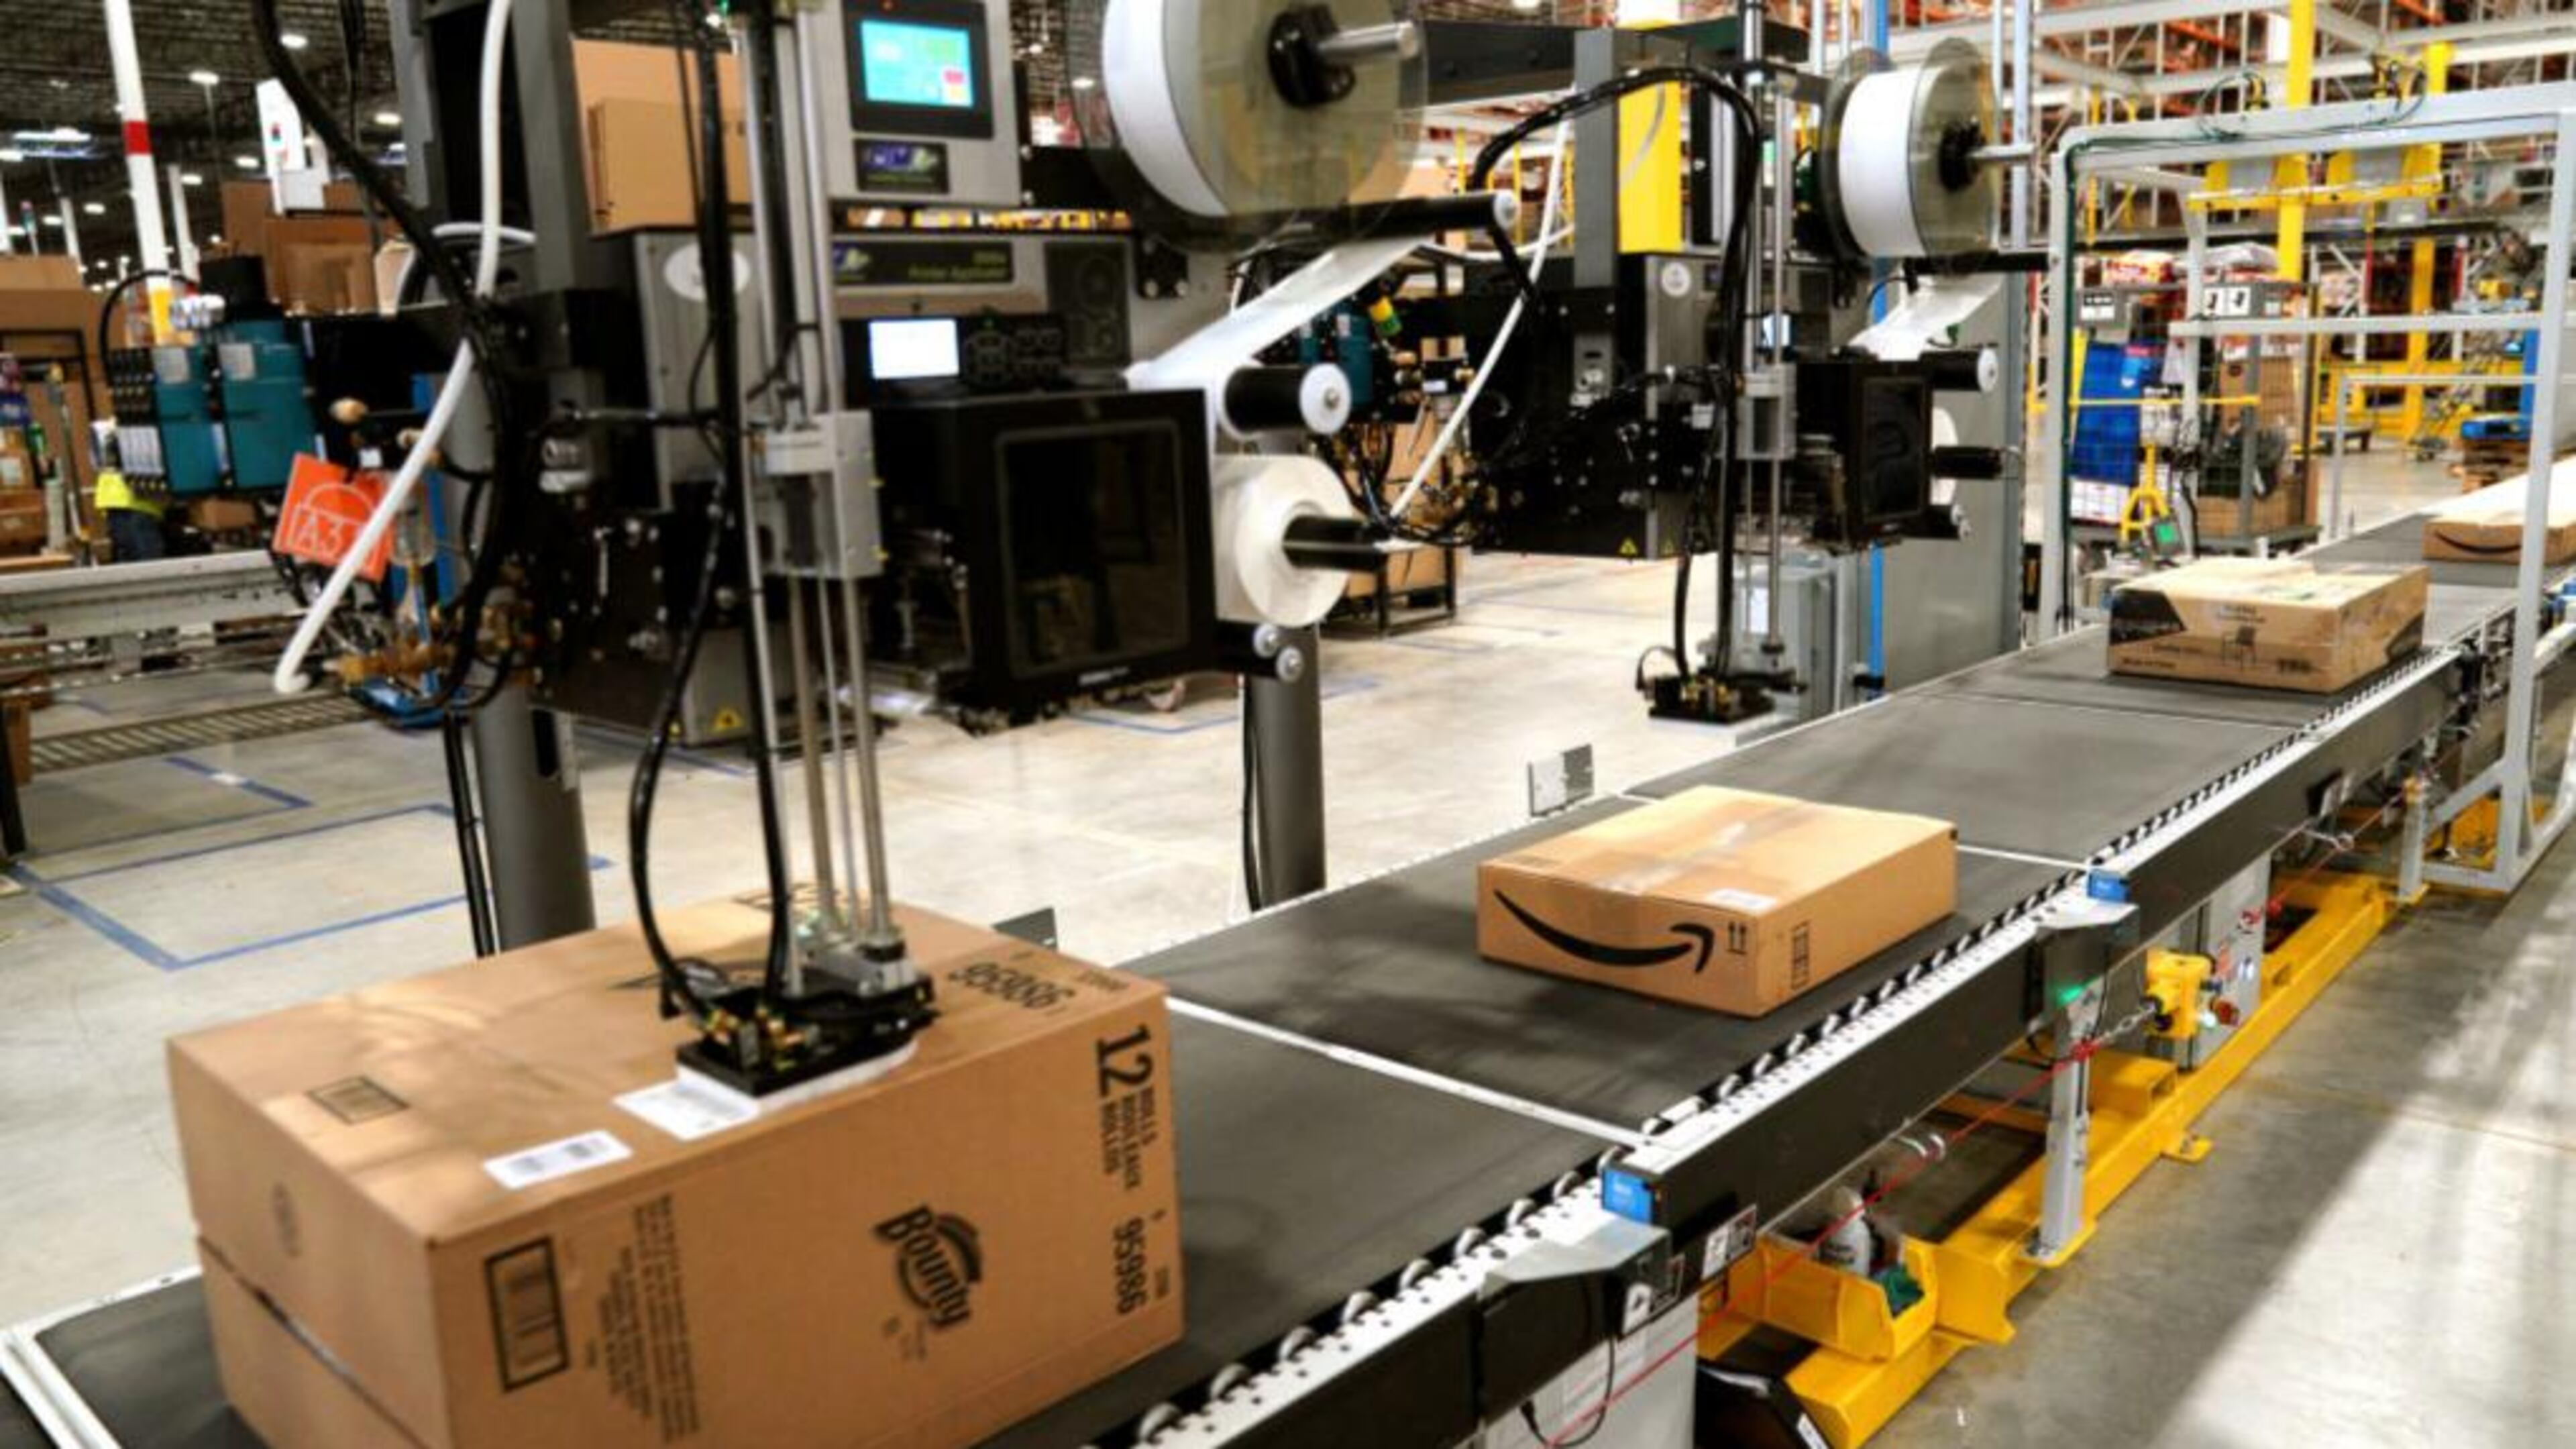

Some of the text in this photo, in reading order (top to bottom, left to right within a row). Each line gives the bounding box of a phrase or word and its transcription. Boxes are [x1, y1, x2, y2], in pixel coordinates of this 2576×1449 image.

[1096, 1024, 1154, 1097] 12
[873, 1205, 971, 1332] Bounty
[1113, 1216, 1148, 1316] 95986
